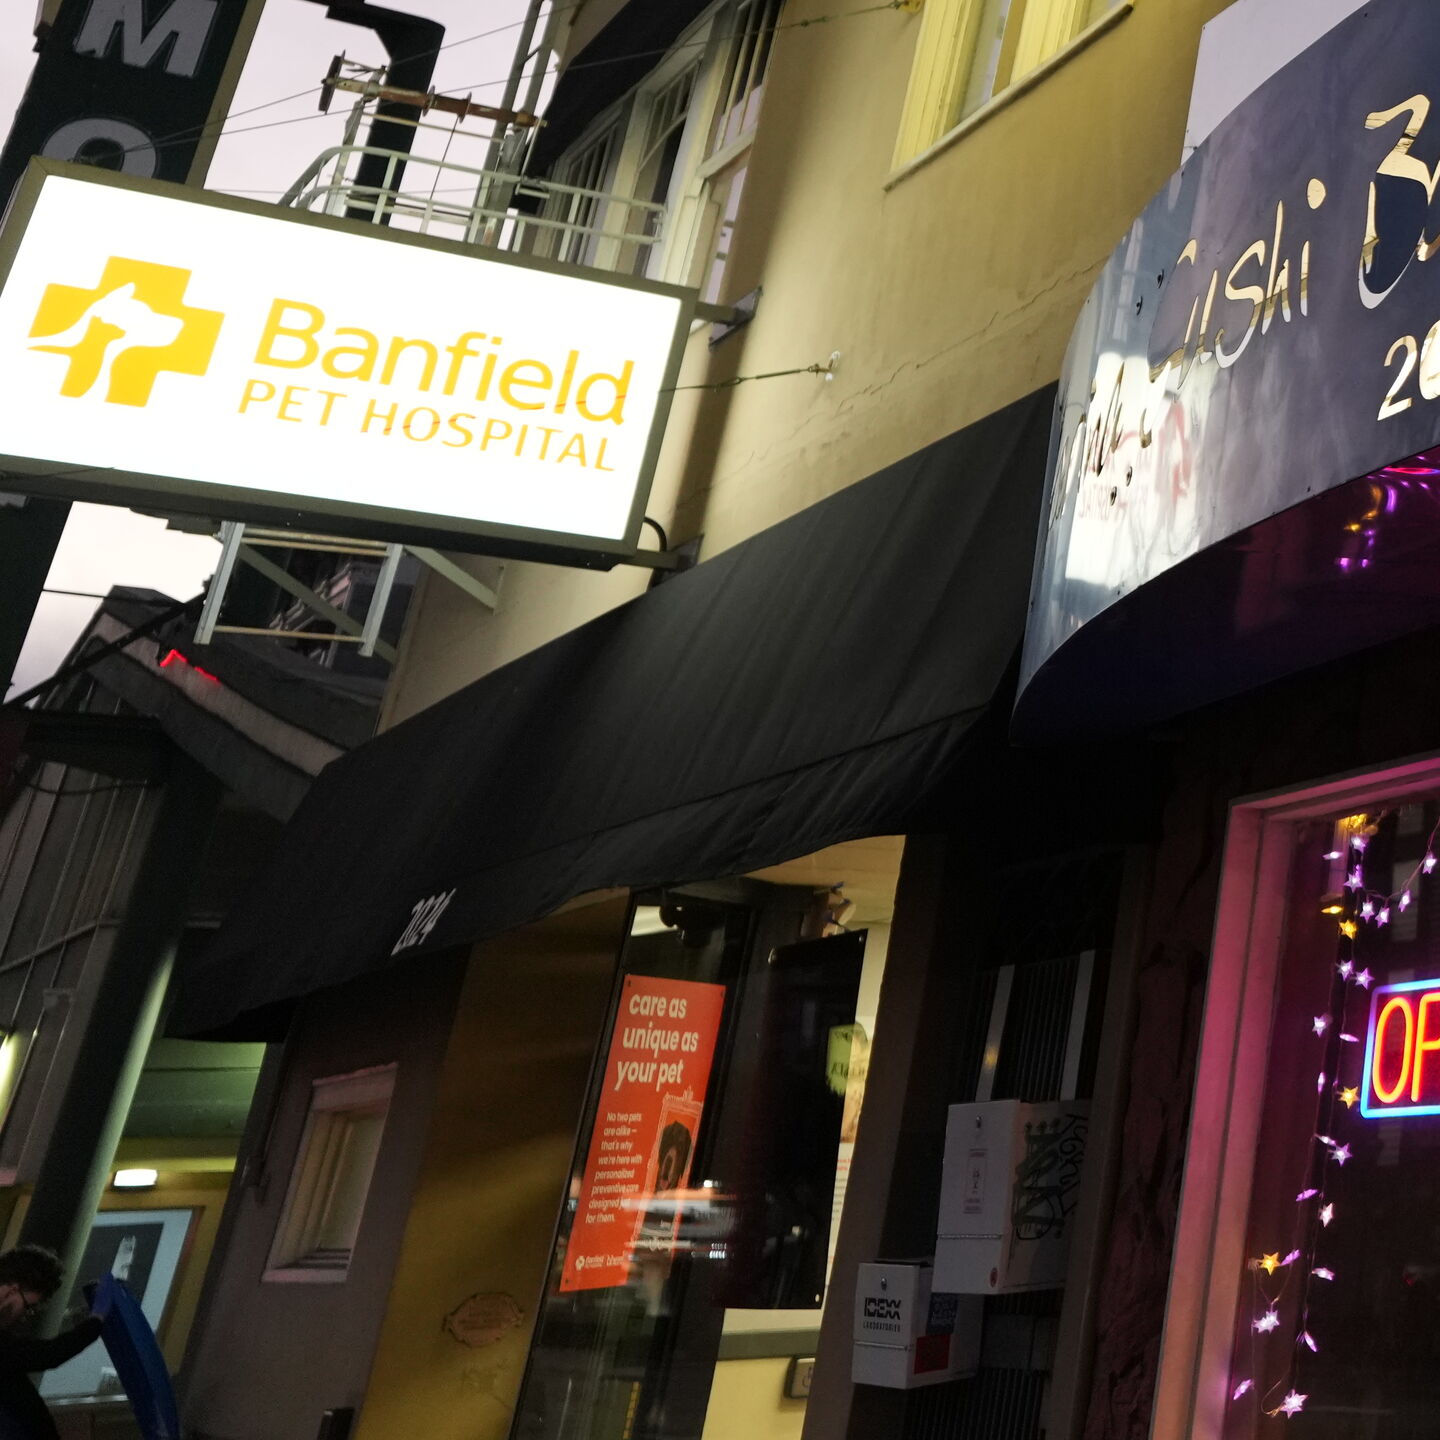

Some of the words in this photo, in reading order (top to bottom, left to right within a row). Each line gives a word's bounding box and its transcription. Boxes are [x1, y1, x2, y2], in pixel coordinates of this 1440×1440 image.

[253, 297, 635, 426] Banfield
[237, 378, 348, 427] PET
[360, 398, 615, 472] HOSPITAL
[629, 993, 667, 1018] care
[668, 998, 688, 1019] as
[622, 1022, 680, 1058] unique
[681, 1031, 699, 1053] as
[614, 1060, 657, 1092] your
[656, 1059, 684, 1092] pet
